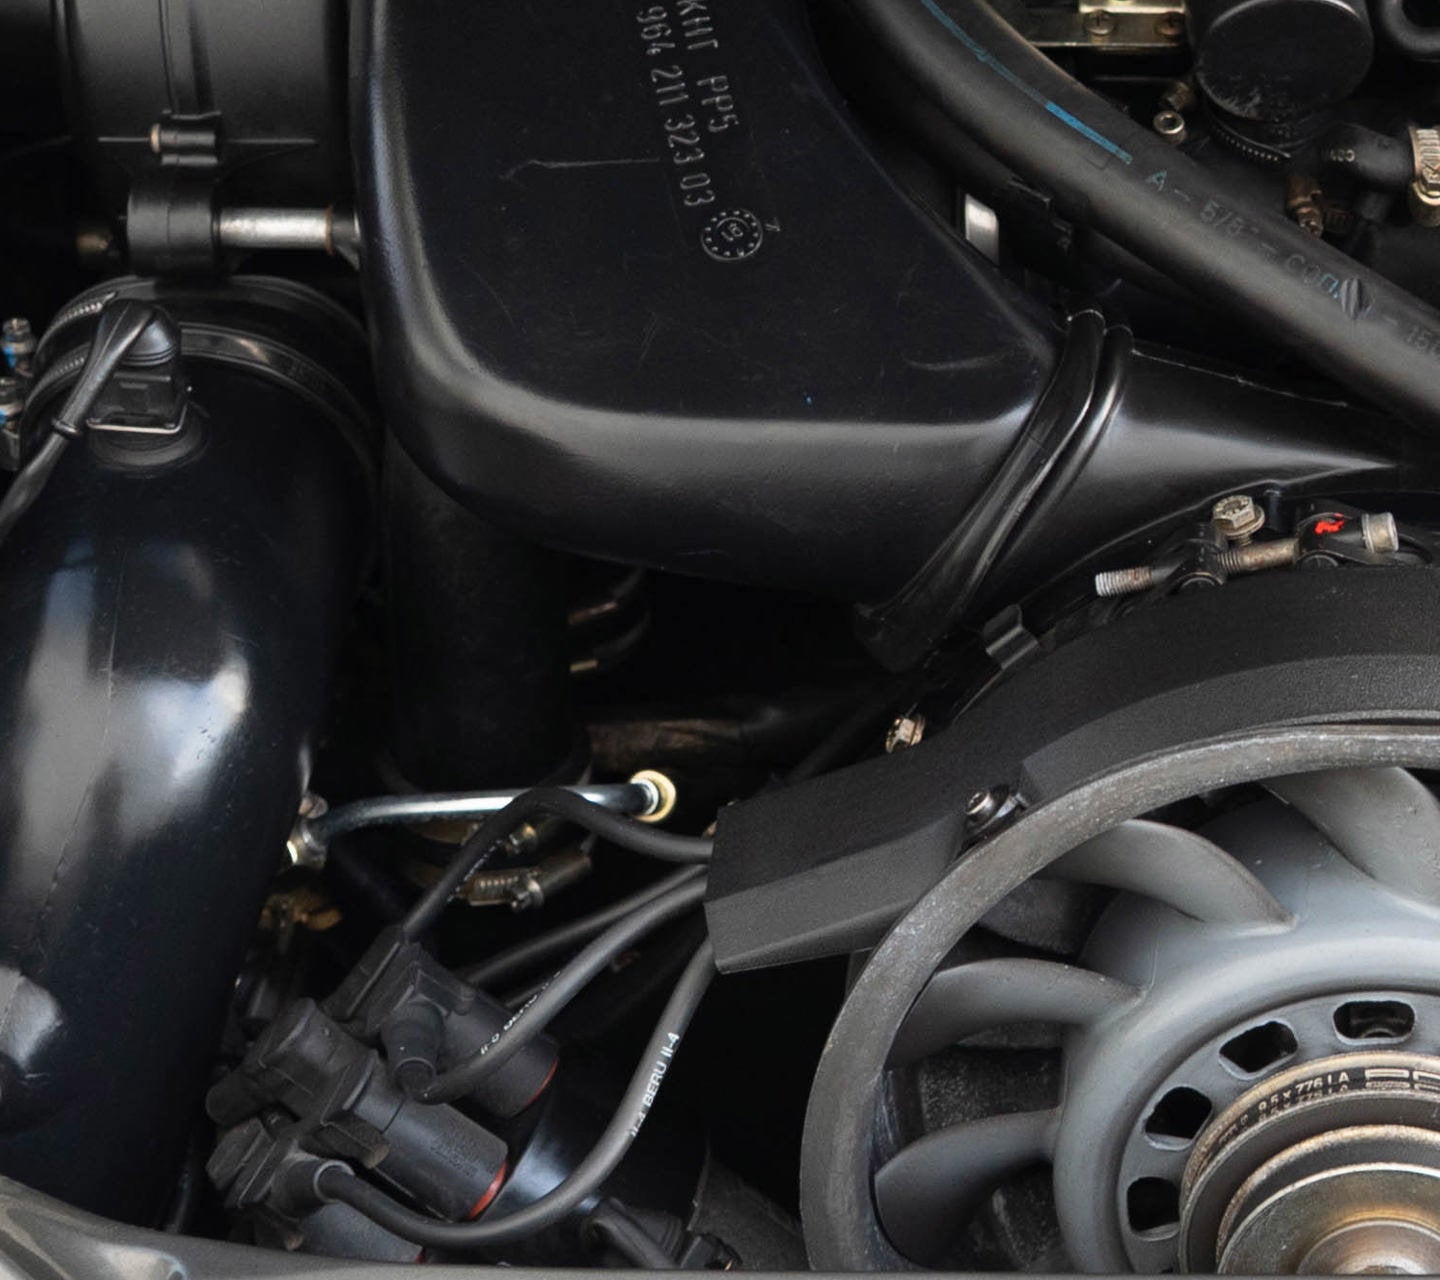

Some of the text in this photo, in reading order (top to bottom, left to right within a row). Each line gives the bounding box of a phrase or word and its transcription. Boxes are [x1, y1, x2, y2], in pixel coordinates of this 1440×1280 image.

[636, 5, 716, 208] 964 211 323 03
[643, 1059, 669, 1108] BERU
[660, 1031, 681, 1058] II-4
